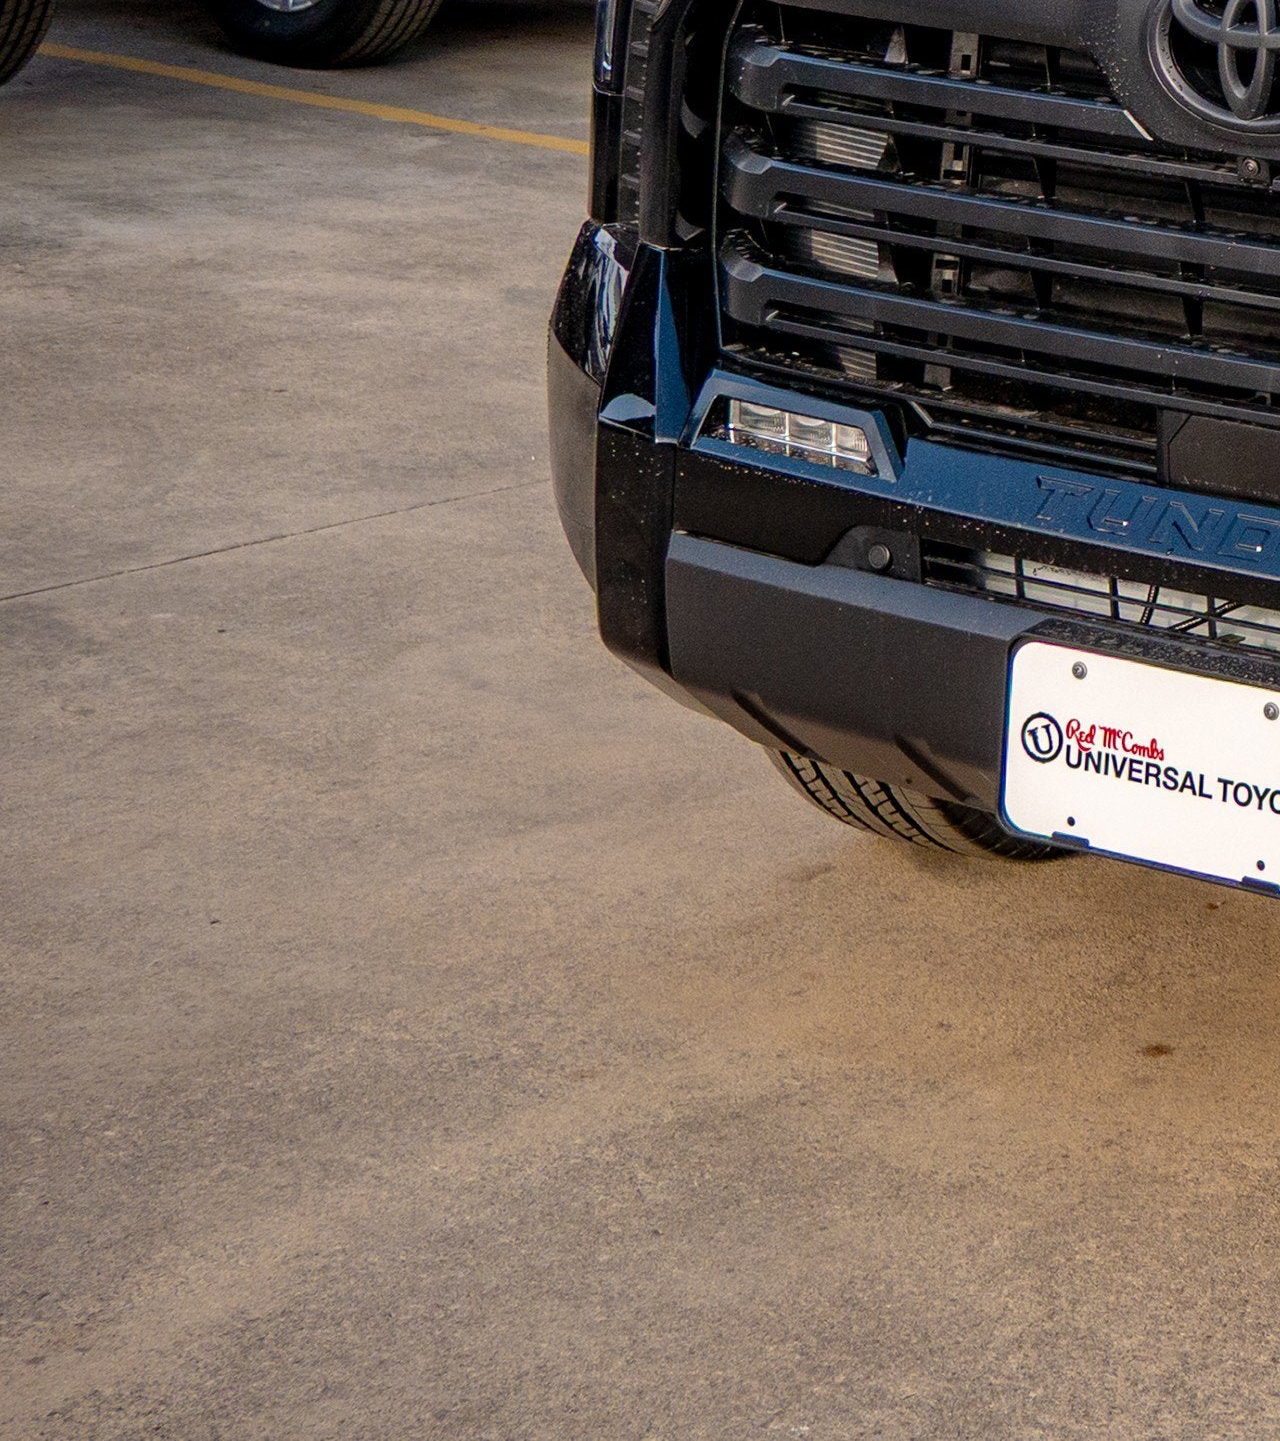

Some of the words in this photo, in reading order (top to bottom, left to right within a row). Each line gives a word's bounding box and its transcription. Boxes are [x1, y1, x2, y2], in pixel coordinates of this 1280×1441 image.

[1066, 719, 1095, 751] Red
[1099, 725, 1164, 761] McCombs
[1066, 744, 1212, 799] UNIVERSAL
